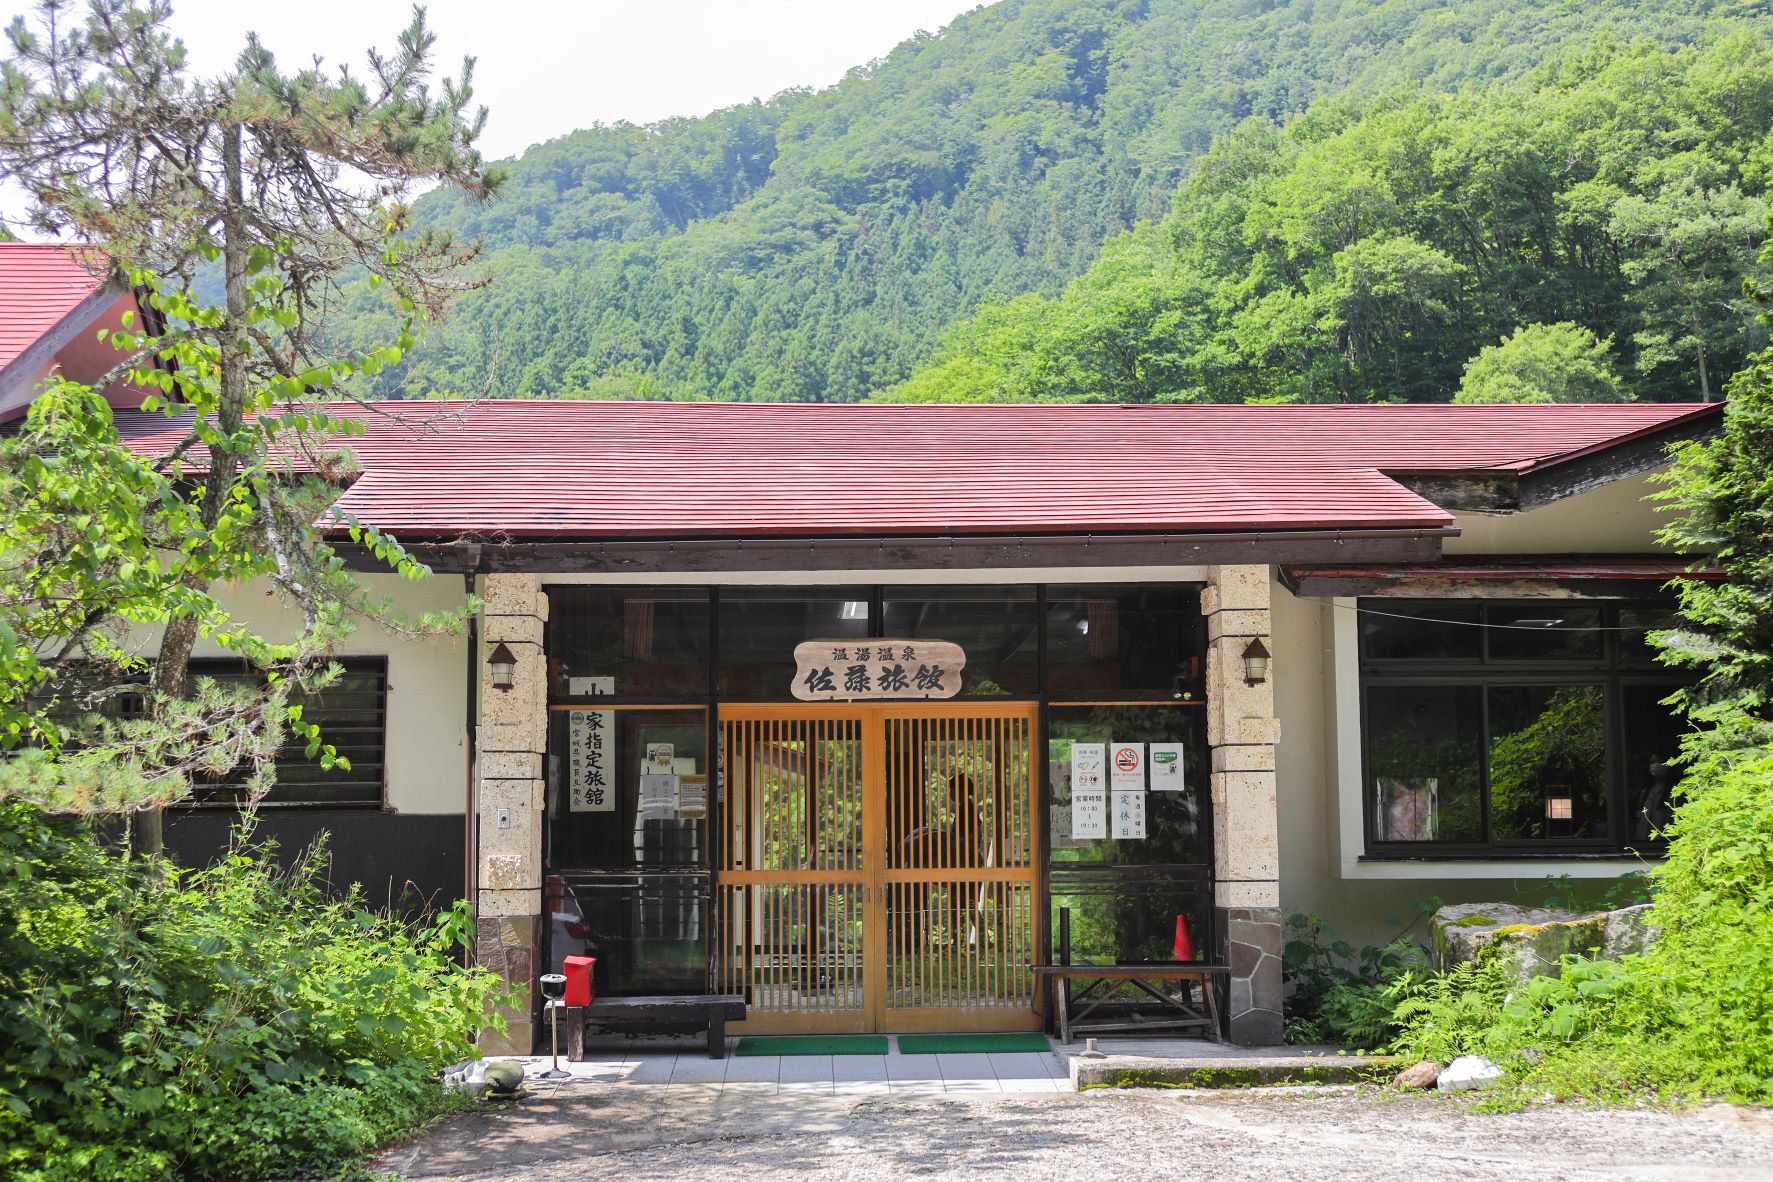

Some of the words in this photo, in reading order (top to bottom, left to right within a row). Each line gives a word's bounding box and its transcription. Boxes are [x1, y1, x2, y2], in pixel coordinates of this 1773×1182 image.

[803, 664, 945, 694] 佐藤旅館
[1075, 795, 1102, 803] 営業時間
[1120, 794, 1131, 837] 定休日
